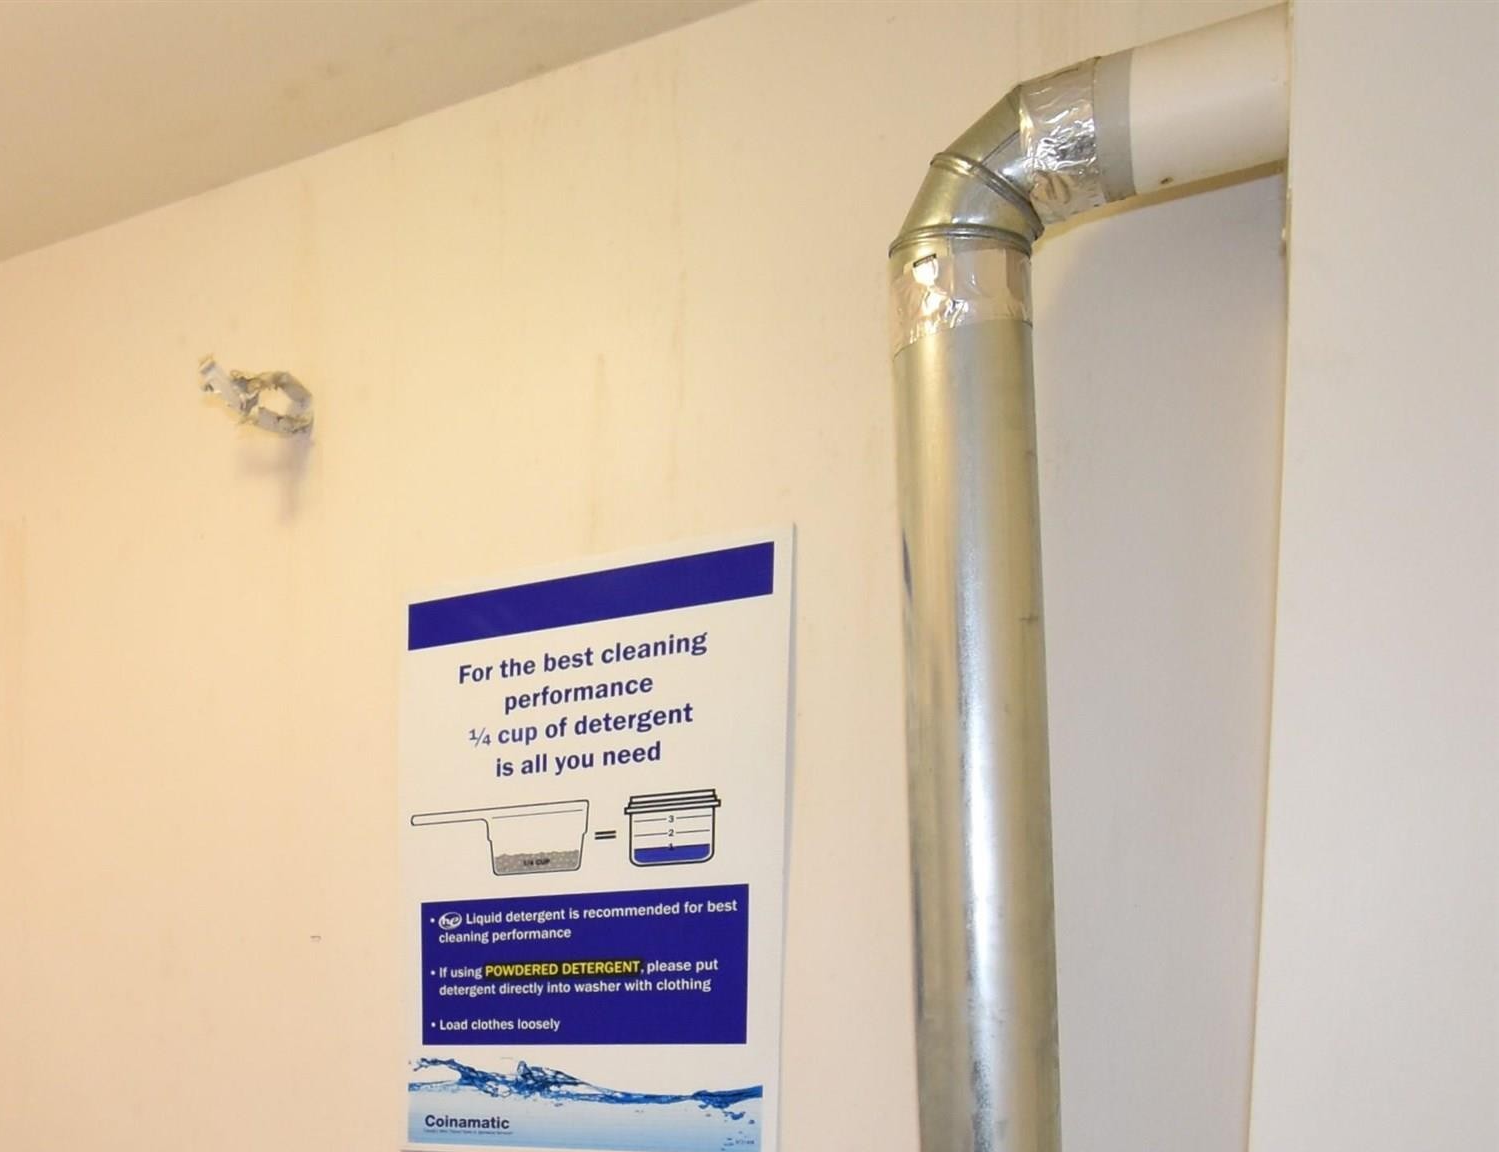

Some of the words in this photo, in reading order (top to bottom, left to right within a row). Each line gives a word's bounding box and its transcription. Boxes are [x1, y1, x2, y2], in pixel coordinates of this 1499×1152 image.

[459, 664, 493, 684] For
[500, 657, 536, 678] the
[543, 647, 594, 673] best
[601, 631, 708, 663] cleaning
[504, 675, 653, 715] performance
[498, 725, 538, 746] cup
[545, 717, 567, 738] of
[573, 703, 693, 736] detergent
[495, 758, 514, 777] is
[520, 754, 548, 776] all
[555, 749, 594, 775] you
[602, 741, 661, 767] need
[668, 815, 675, 823] 3
[668, 829, 675, 837] 2
[535, 858, 550, 866] CUP
[466, 911, 502, 927] Liquid
[505, 908, 565, 925] detergent
[569, 907, 580, 920] is
[583, 903, 680, 920] recommended
[683, 901, 703, 914] for
[707, 899, 738, 914] best
[438, 929, 489, 945] cleaning
[492, 926, 572, 944] performance
[439, 966, 447, 978] If
[450, 965, 483, 980] using
[484, 962, 559, 978] POWDERED
[562, 960, 644, 976] DETERGENT,
[646, 959, 692, 975] please
[695, 958, 719, 974] put
[438, 982, 496, 997] detergent
[499, 980, 544, 996] directly
[546, 980, 571, 994] into
[574, 979, 621, 993] washer
[624, 978, 653, 992] with
[656, 976, 711, 993] clothing
[440, 1018, 468, 1031] Load
[471, 1017, 514, 1031] clothes
[517, 1016, 560, 1033] loosely
[424, 1113, 510, 1130] Coinamatic
